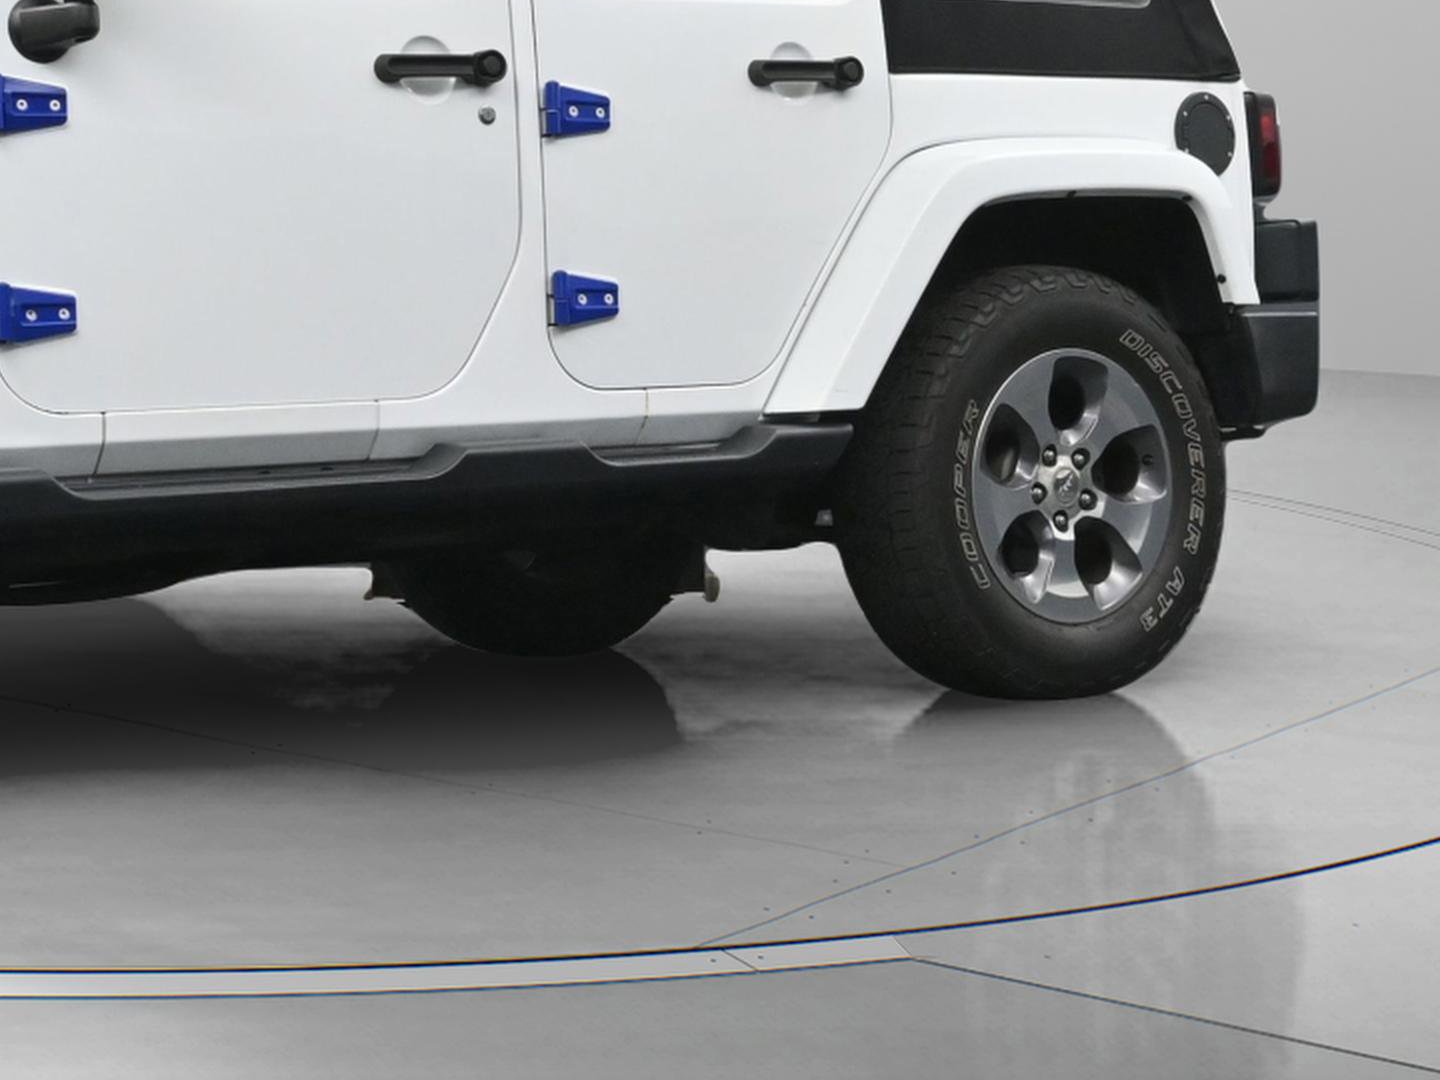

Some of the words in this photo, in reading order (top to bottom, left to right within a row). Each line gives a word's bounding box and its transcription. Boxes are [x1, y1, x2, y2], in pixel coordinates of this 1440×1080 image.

[953, 398, 992, 590] COOPER
[1119, 328, 1207, 556] DISCOVERER
[1139, 566, 1186, 633] AT3
